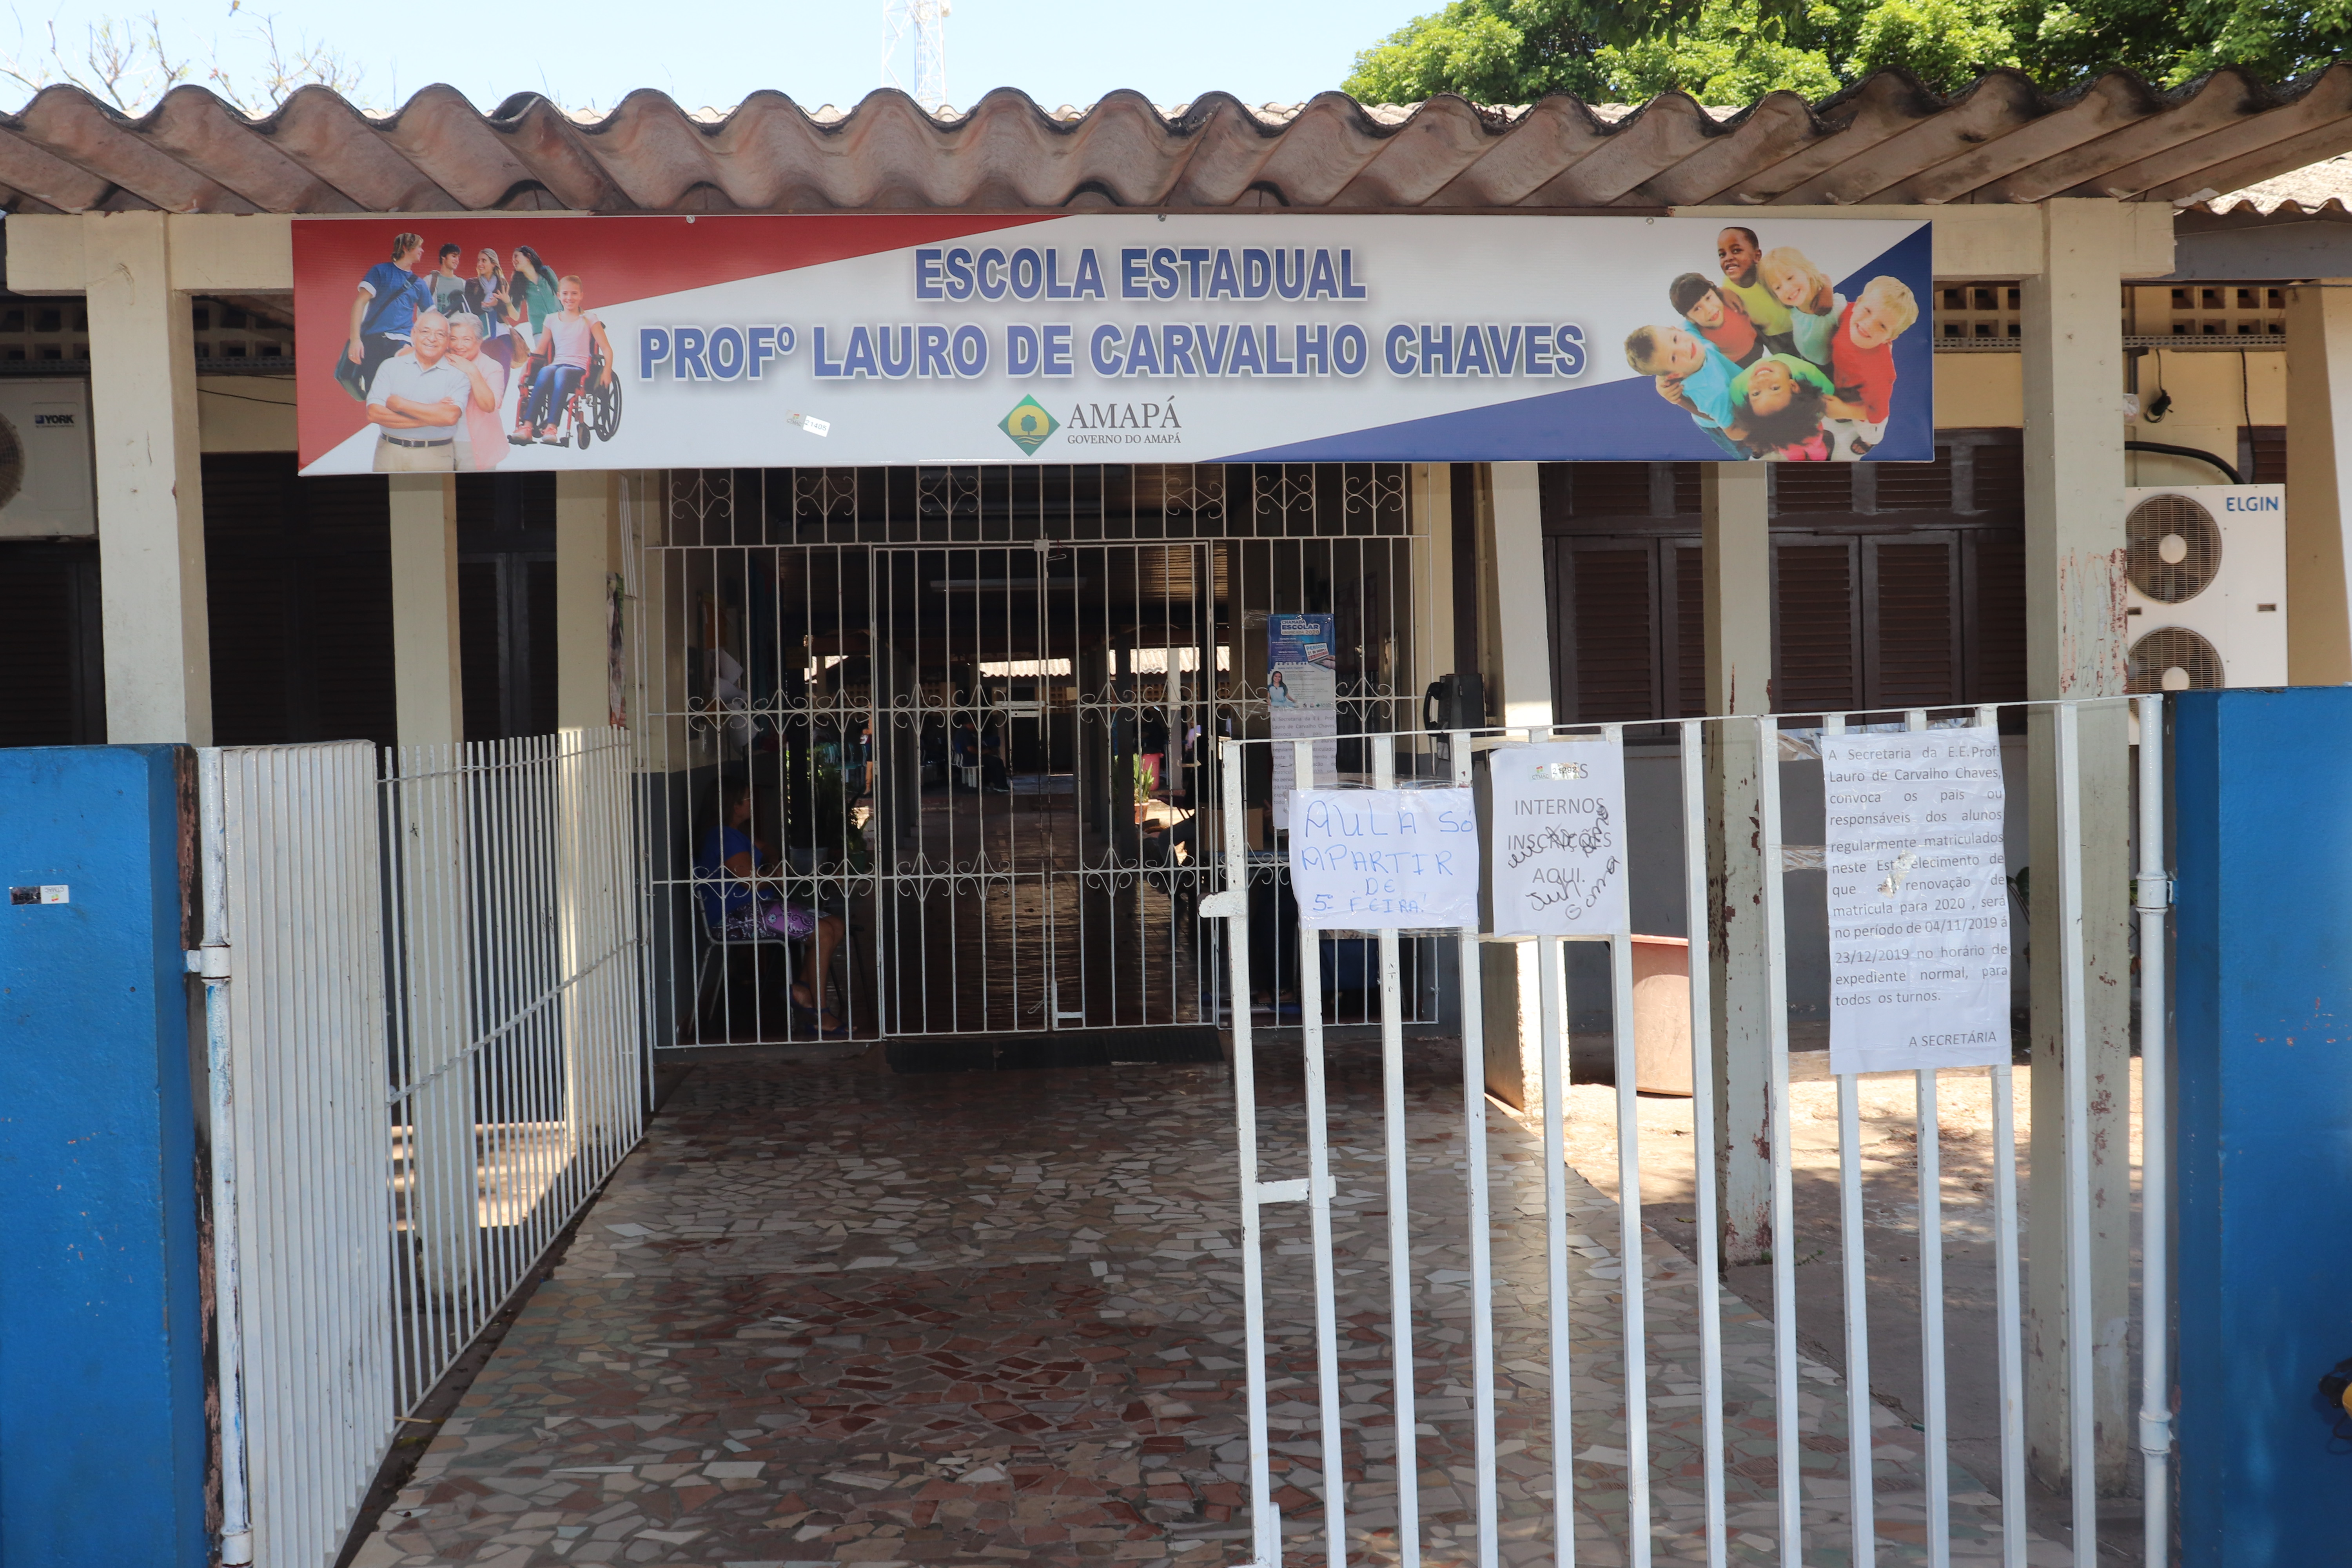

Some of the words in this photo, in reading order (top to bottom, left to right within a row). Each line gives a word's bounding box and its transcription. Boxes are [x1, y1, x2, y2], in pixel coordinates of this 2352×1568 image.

[915, 247, 1106, 300] ESCOLA
[1120, 247, 1367, 300] ESTADUAL
[812, 323, 989, 379] LAURO
[1006, 323, 1073, 377] DE
[1090, 321, 1368, 377] CARVALHO
[1384, 322, 1586, 377] CHAVES
[44, 415, 74, 424] YORK
[1067, 395, 1181, 428] AMAPÁ
[805, 419, 827, 431] 21405
[1067, 434, 1122, 444] GOVERNO
[1125, 434, 1141, 444] DO
[1144, 432, 1181, 443] AMAPÁ
[2226, 496, 2278, 512] ELGIN
[1828, 750, 1837, 760] A
[1848, 748, 1911, 760] Secretaria
[1922, 746, 1937, 758] da
[1830, 771, 1865, 782] Lauro
[1872, 769, 1887, 781] de
[1895, 768, 1948, 780] Carvalho
[1956, 767, 2001, 779] Chaves,
[1830, 794, 1881, 804] convoca
[1904, 793, 1917, 801] os
[1940, 789, 1965, 803] pais
[1987, 790, 2002, 799] ou
[1515, 798, 1604, 815] INTERNOS
[1305, 799, 1416, 837] AULA
[1830, 812, 1910, 827] responsáveis
[1926, 810, 1947, 822] dos
[1962, 809, 2002, 820] alunos
[1831, 838, 1916, 854] regularmente
[1924, 832, 2004, 846] matriculados
[1832, 862, 1866, 874] neste
[1989, 853, 2004, 864] de
[1532, 867, 1585, 886] AQUI.
[1832, 885, 1856, 898] que
[1906, 876, 1971, 891] renovação
[1991, 874, 2005, 885] de
[1365, 877, 1395, 896] DE
[1833, 902, 1893, 916] matricula
[1900, 902, 1927, 915] para
[1935, 897, 1965, 910] 2020
[1981, 894, 2006, 907] será
[1835, 929, 1850, 938] no
[1854, 924, 1903, 939] período
[1906, 922, 1922, 933] de
[1925, 916, 1997, 933] 04/11/2019
[2001, 915, 2007, 927] á
[1835, 948, 1909, 964] 23/12/2019
[1917, 949, 1933, 959] no
[1941, 945, 1985, 958] horário
[1992, 943, 2007, 955] de
[1835, 971, 1906, 987] expediente
[1920, 966, 1968, 980] normal,
[1982, 966, 2007, 979] para
[1835, 994, 1871, 1006] todos
[1878, 994, 1893, 1004] os
[1896, 992, 1941, 1003] turnos.
[1909, 1036, 1918, 1047] A
[1921, 1030, 1997, 1047] SECRETÁRIA
